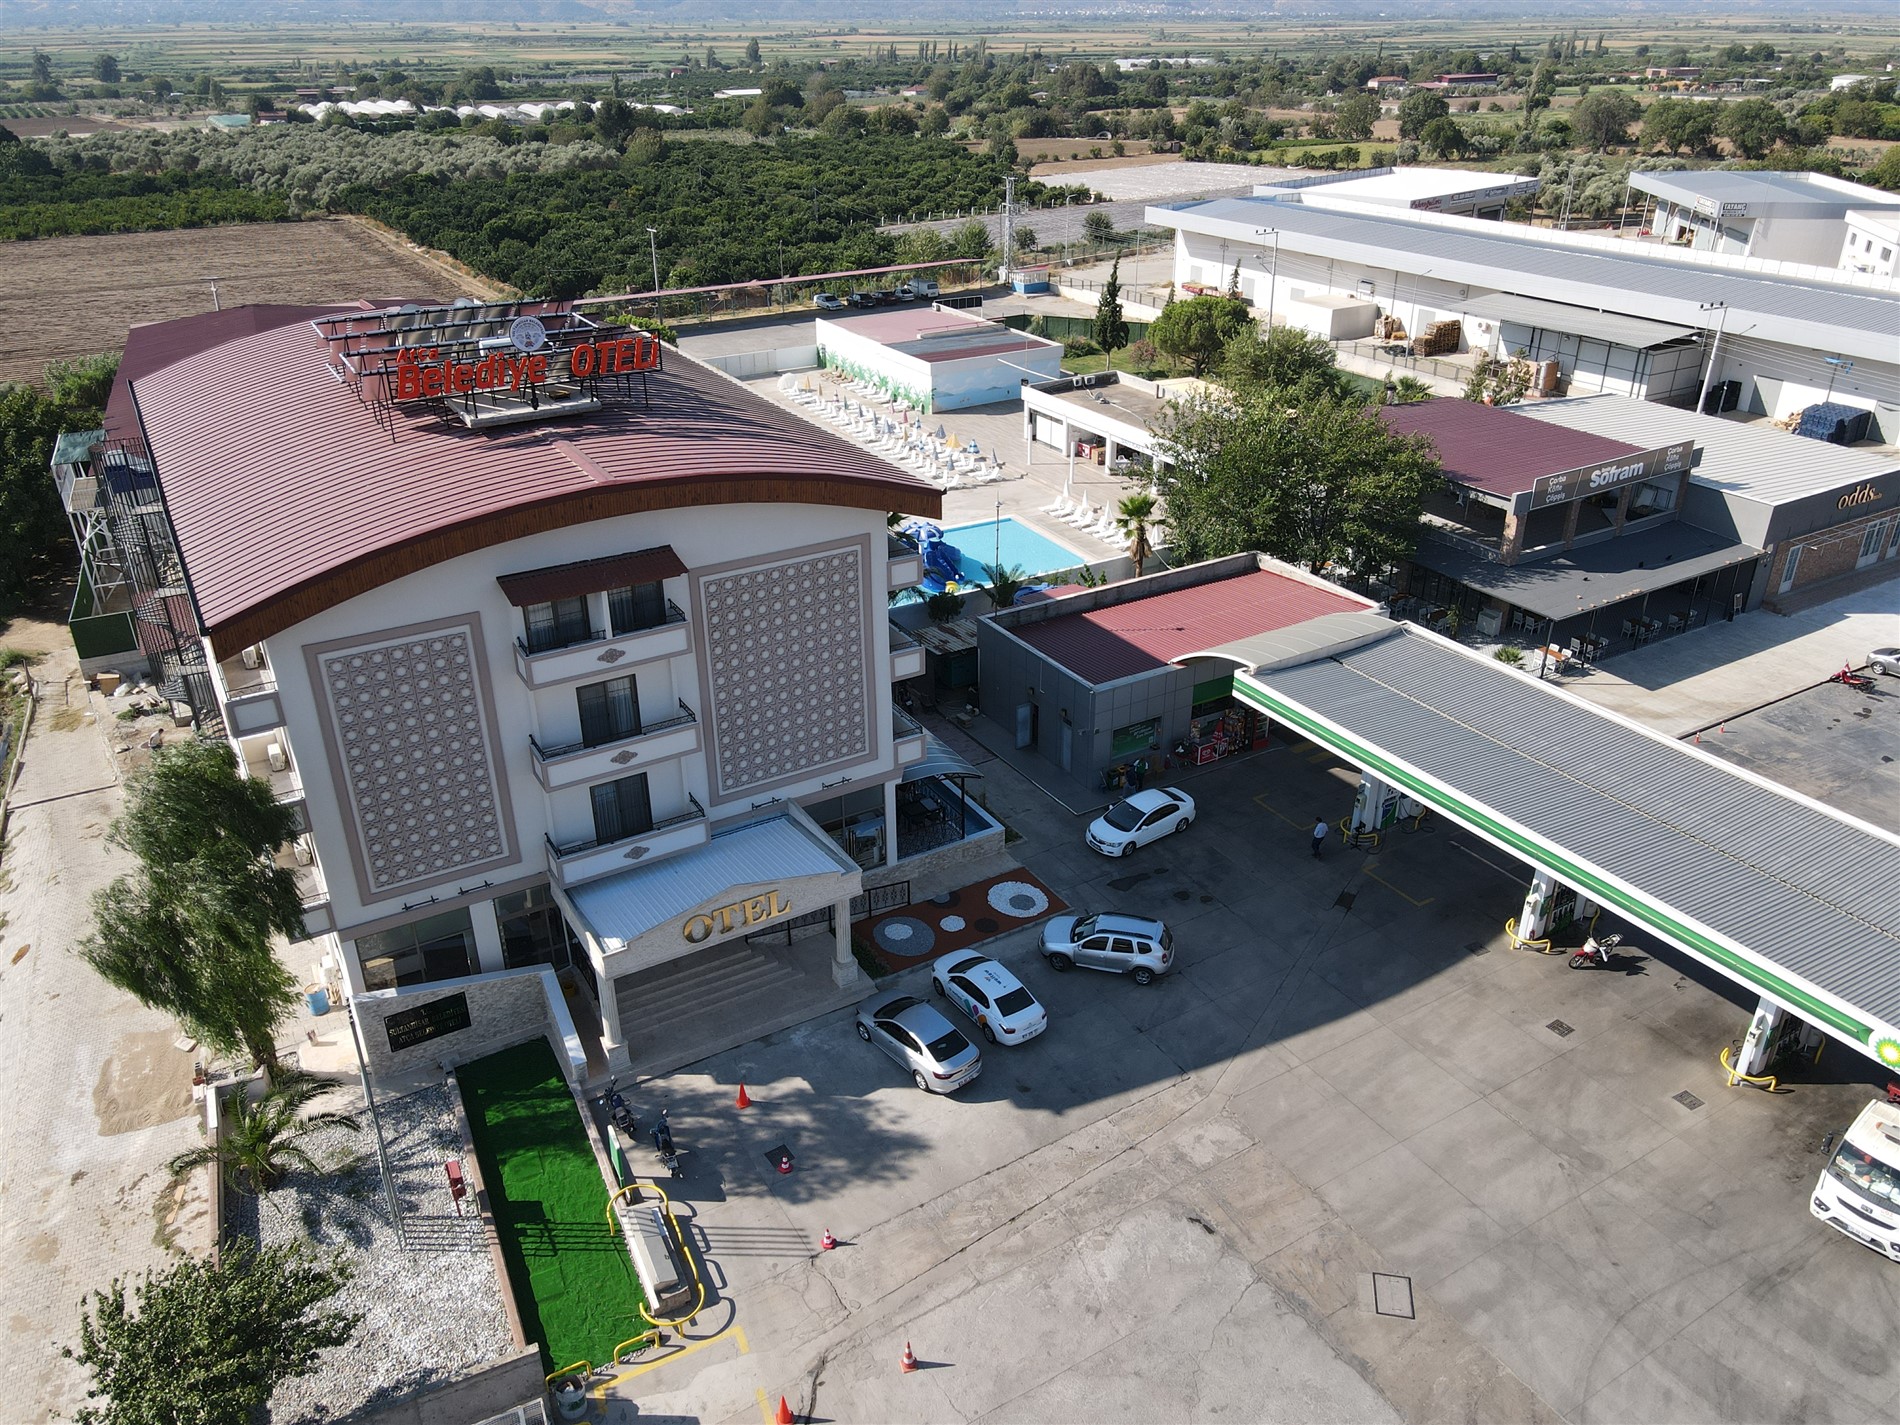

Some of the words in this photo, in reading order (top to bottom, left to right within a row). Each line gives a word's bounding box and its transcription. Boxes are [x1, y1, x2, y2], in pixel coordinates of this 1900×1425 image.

[397, 351, 548, 400] Belediye
[571, 332, 659, 377] OTELİ
[1837, 483, 1876, 510] odds
[682, 889, 792, 944] OTEL
